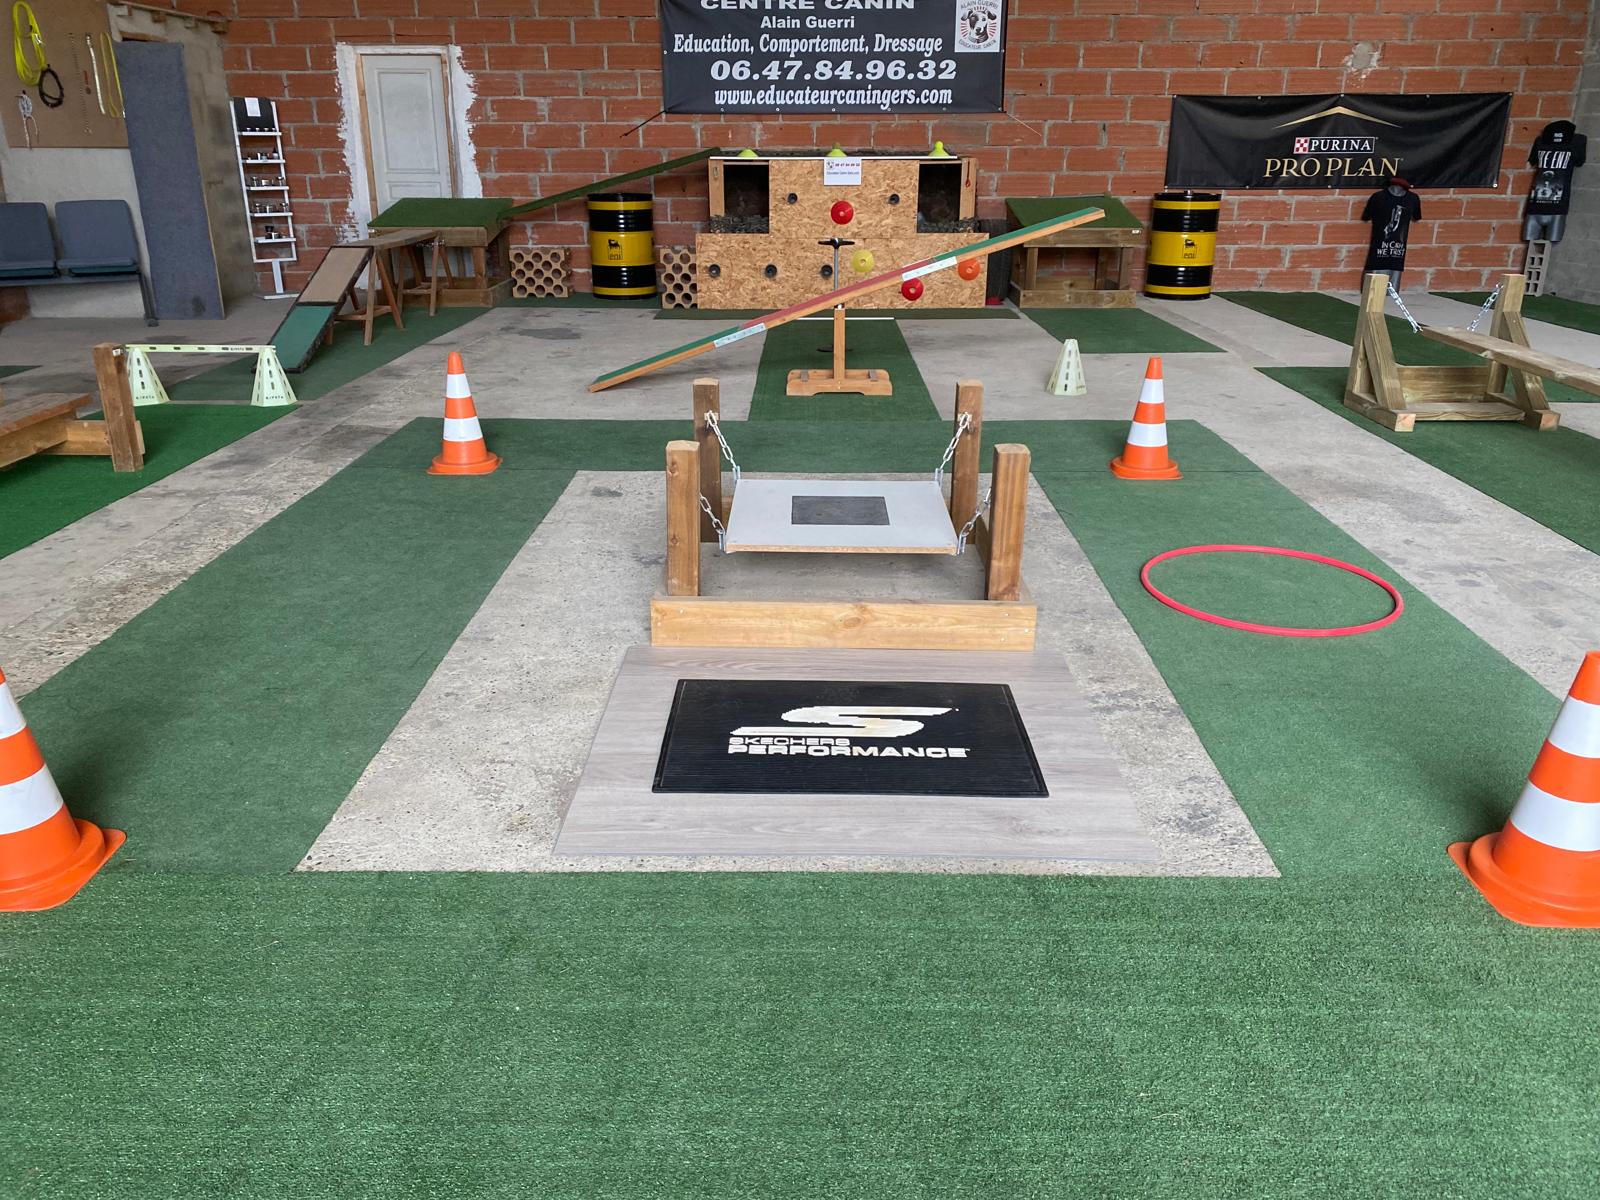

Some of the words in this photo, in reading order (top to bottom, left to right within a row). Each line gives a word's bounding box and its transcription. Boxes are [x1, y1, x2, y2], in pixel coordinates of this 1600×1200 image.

[760, 15, 801, 29] Alain
[805, 15, 855, 29] Guerri
[673, 33, 754, 55] Education,
[759, 33, 869, 58] Comportement,
[873, 33, 943, 57] Dressage
[710, 59, 957, 80] 06.47.84.96.32
[714, 83, 953, 110] www.educateurcaningers.com
[1311, 139, 1371, 151] PURINA
[1263, 157, 1321, 178] PRO
[1324, 157, 1400, 177] PLAN
[728, 737, 850, 746] SKECHERS
[727, 745, 968, 758] PERFORMANCE
